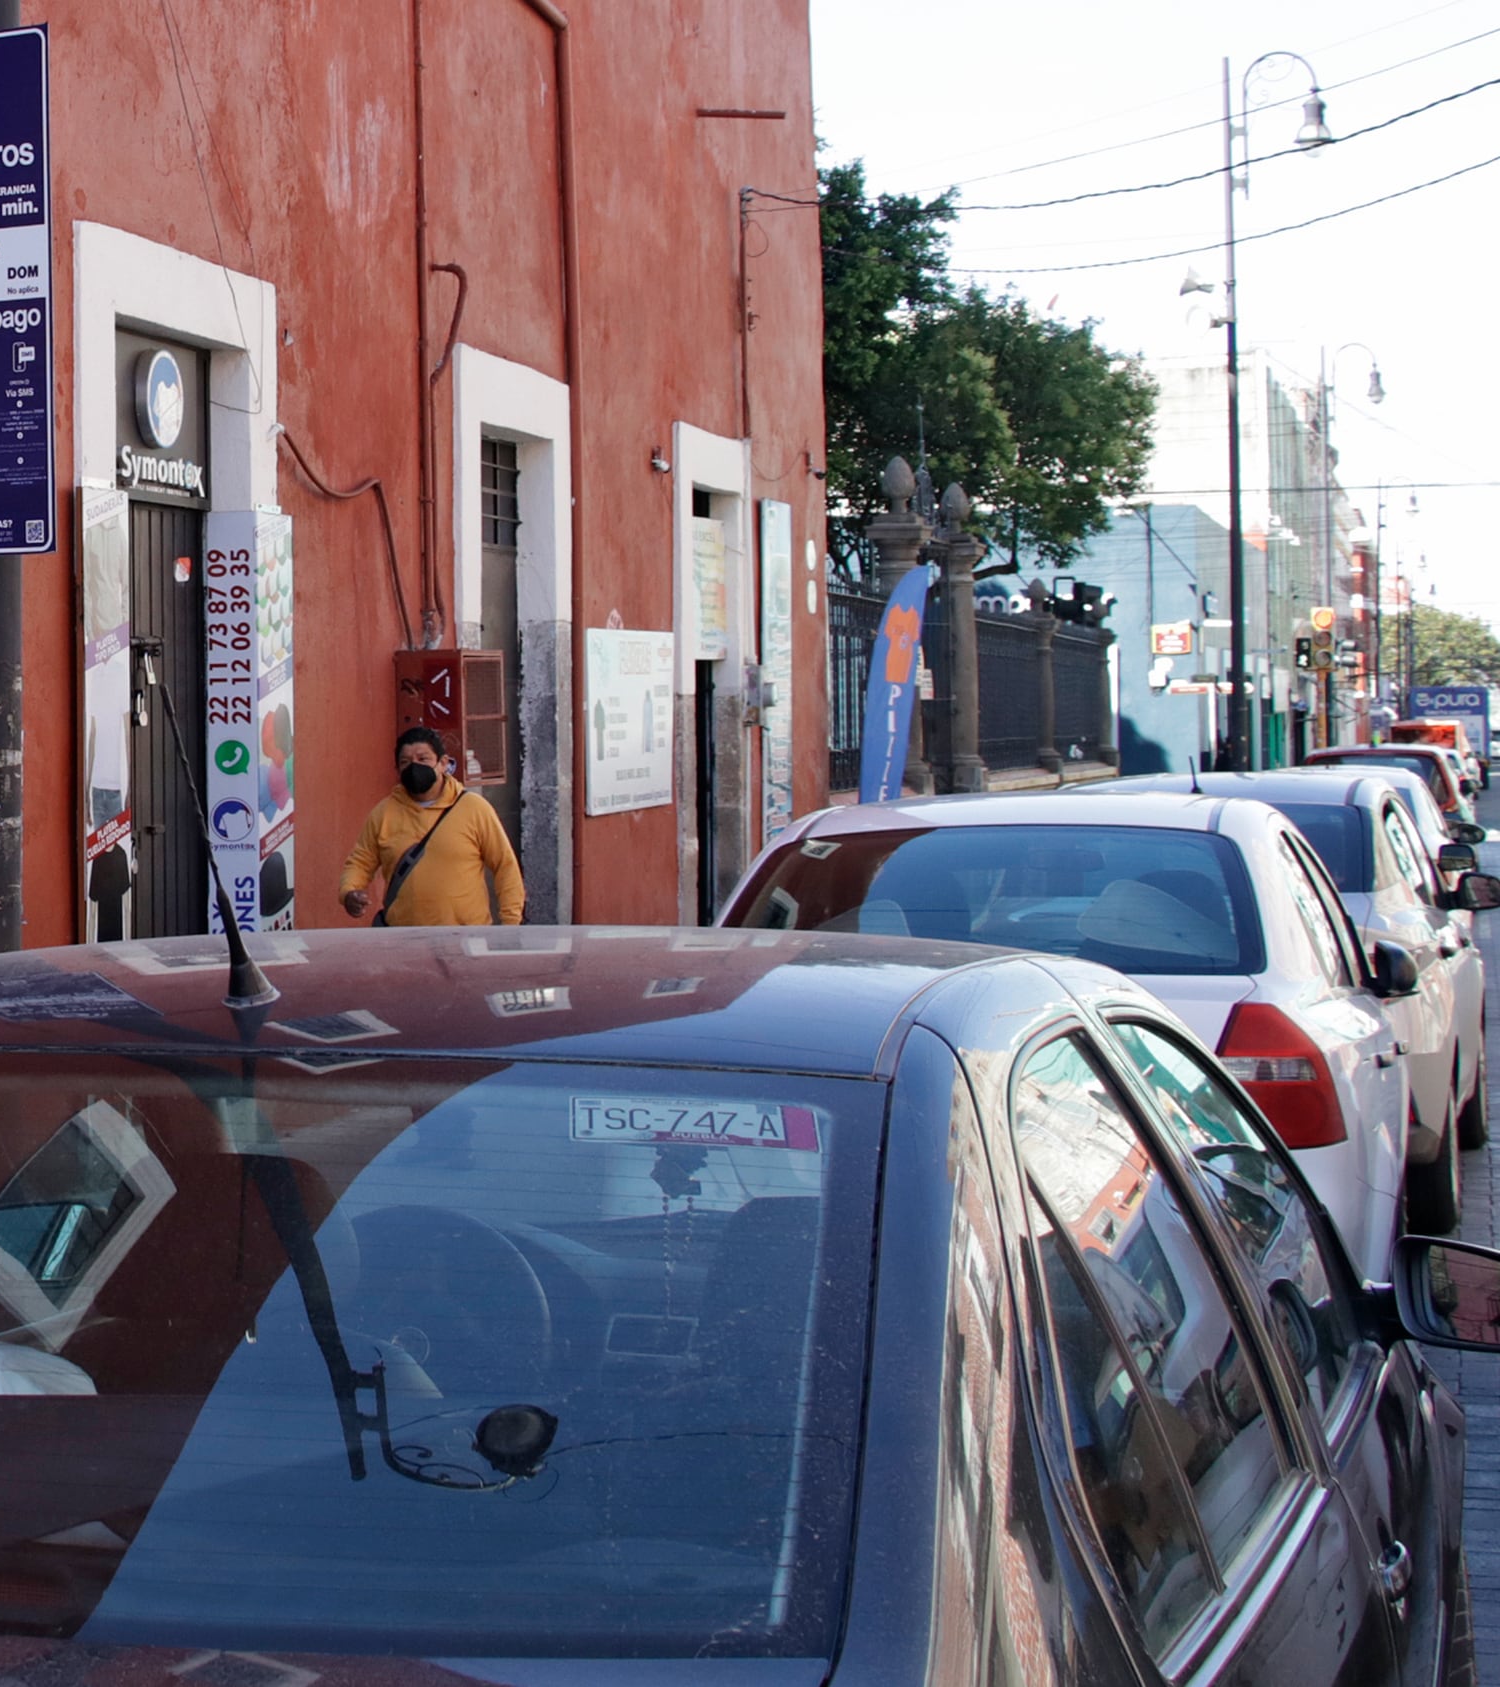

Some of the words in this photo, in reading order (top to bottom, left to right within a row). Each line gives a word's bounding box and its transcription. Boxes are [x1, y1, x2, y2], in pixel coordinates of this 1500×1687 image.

[1, 198, 39, 216] min.
[7, 264, 39, 280] DOM
[207, 548, 228, 578] 09
[229, 548, 250, 577] 35
[207, 586, 228, 614] 87
[230, 585, 250, 613] 39
[208, 622, 228, 651] 73
[231, 621, 251, 651] 06
[209, 660, 228, 686] 11
[231, 659, 251, 686] 12
[209, 695, 228, 724] 22
[231, 695, 251, 724] 22
[580, 1106, 780, 1138] TSC-747-A
